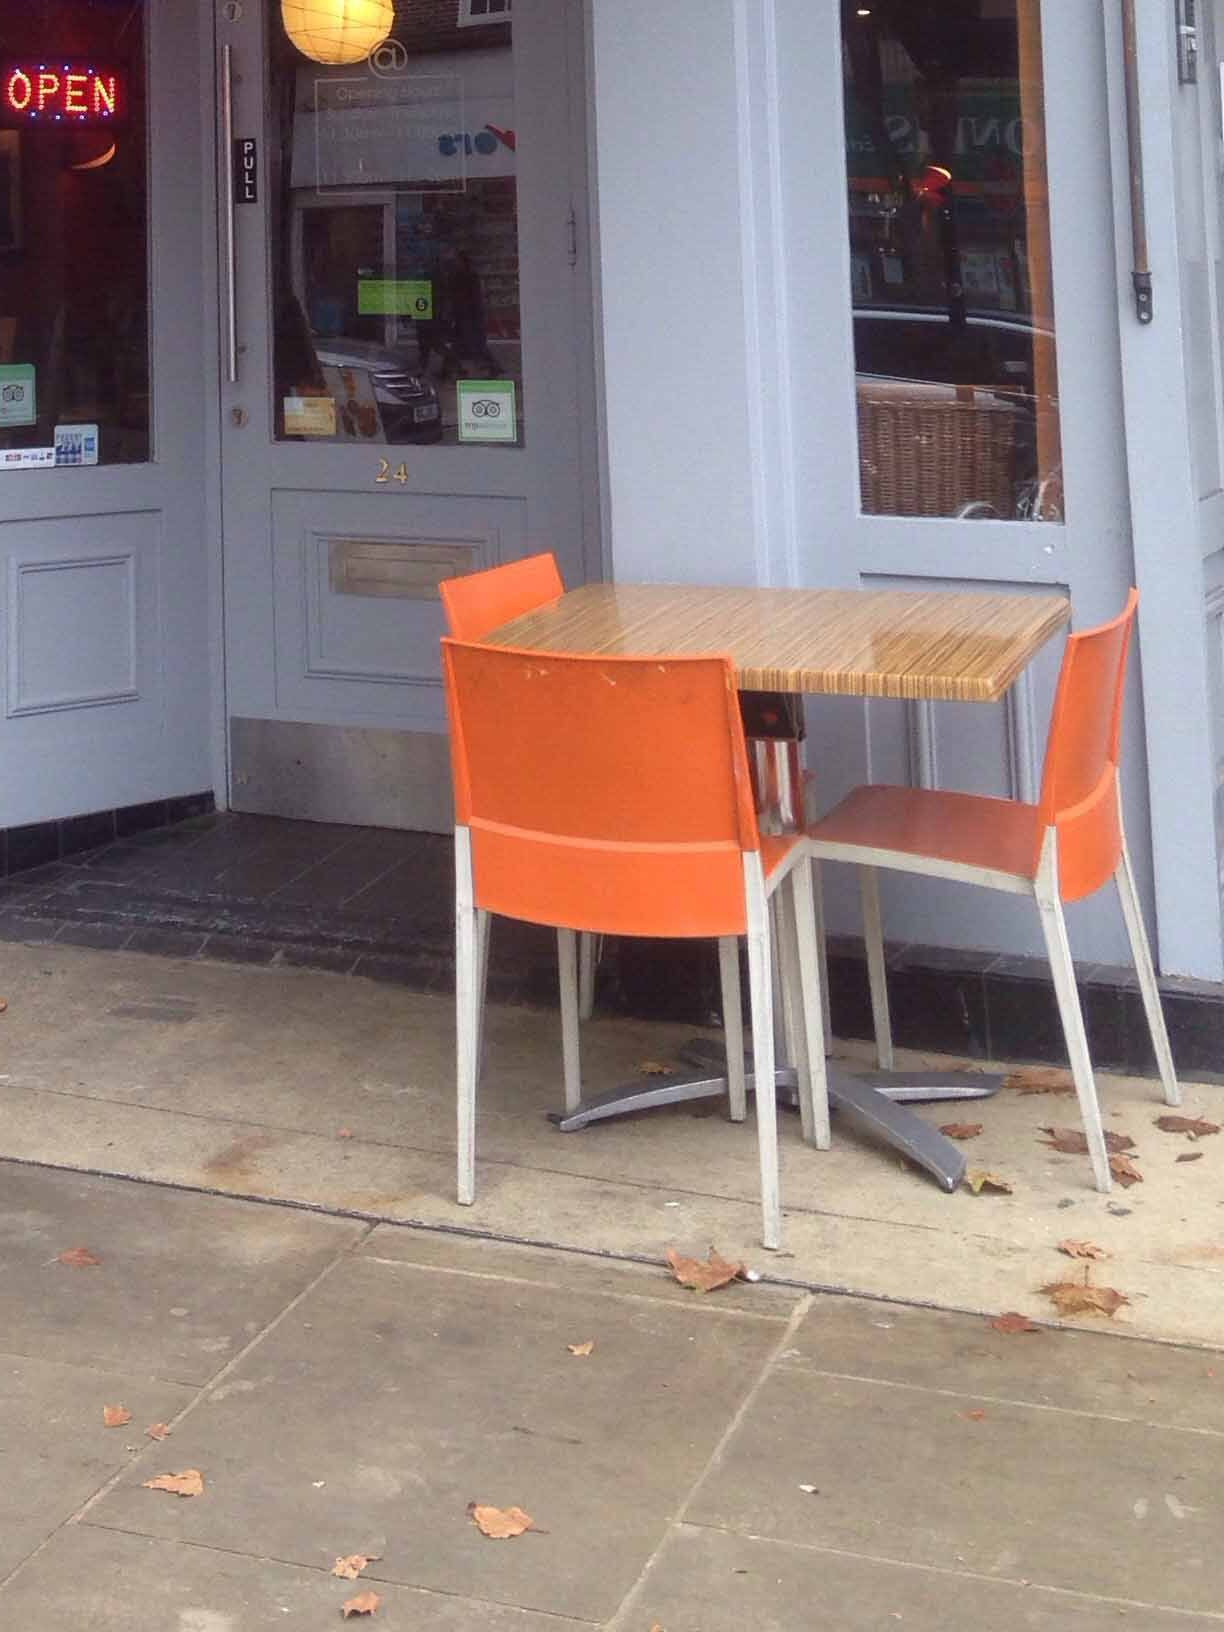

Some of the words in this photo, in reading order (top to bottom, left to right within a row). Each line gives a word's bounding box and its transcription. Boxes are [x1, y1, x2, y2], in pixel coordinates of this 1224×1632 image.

[7, 72, 115, 113] OPEN
[244, 142, 254, 198] PULL
[376, 457, 408, 484] 24
